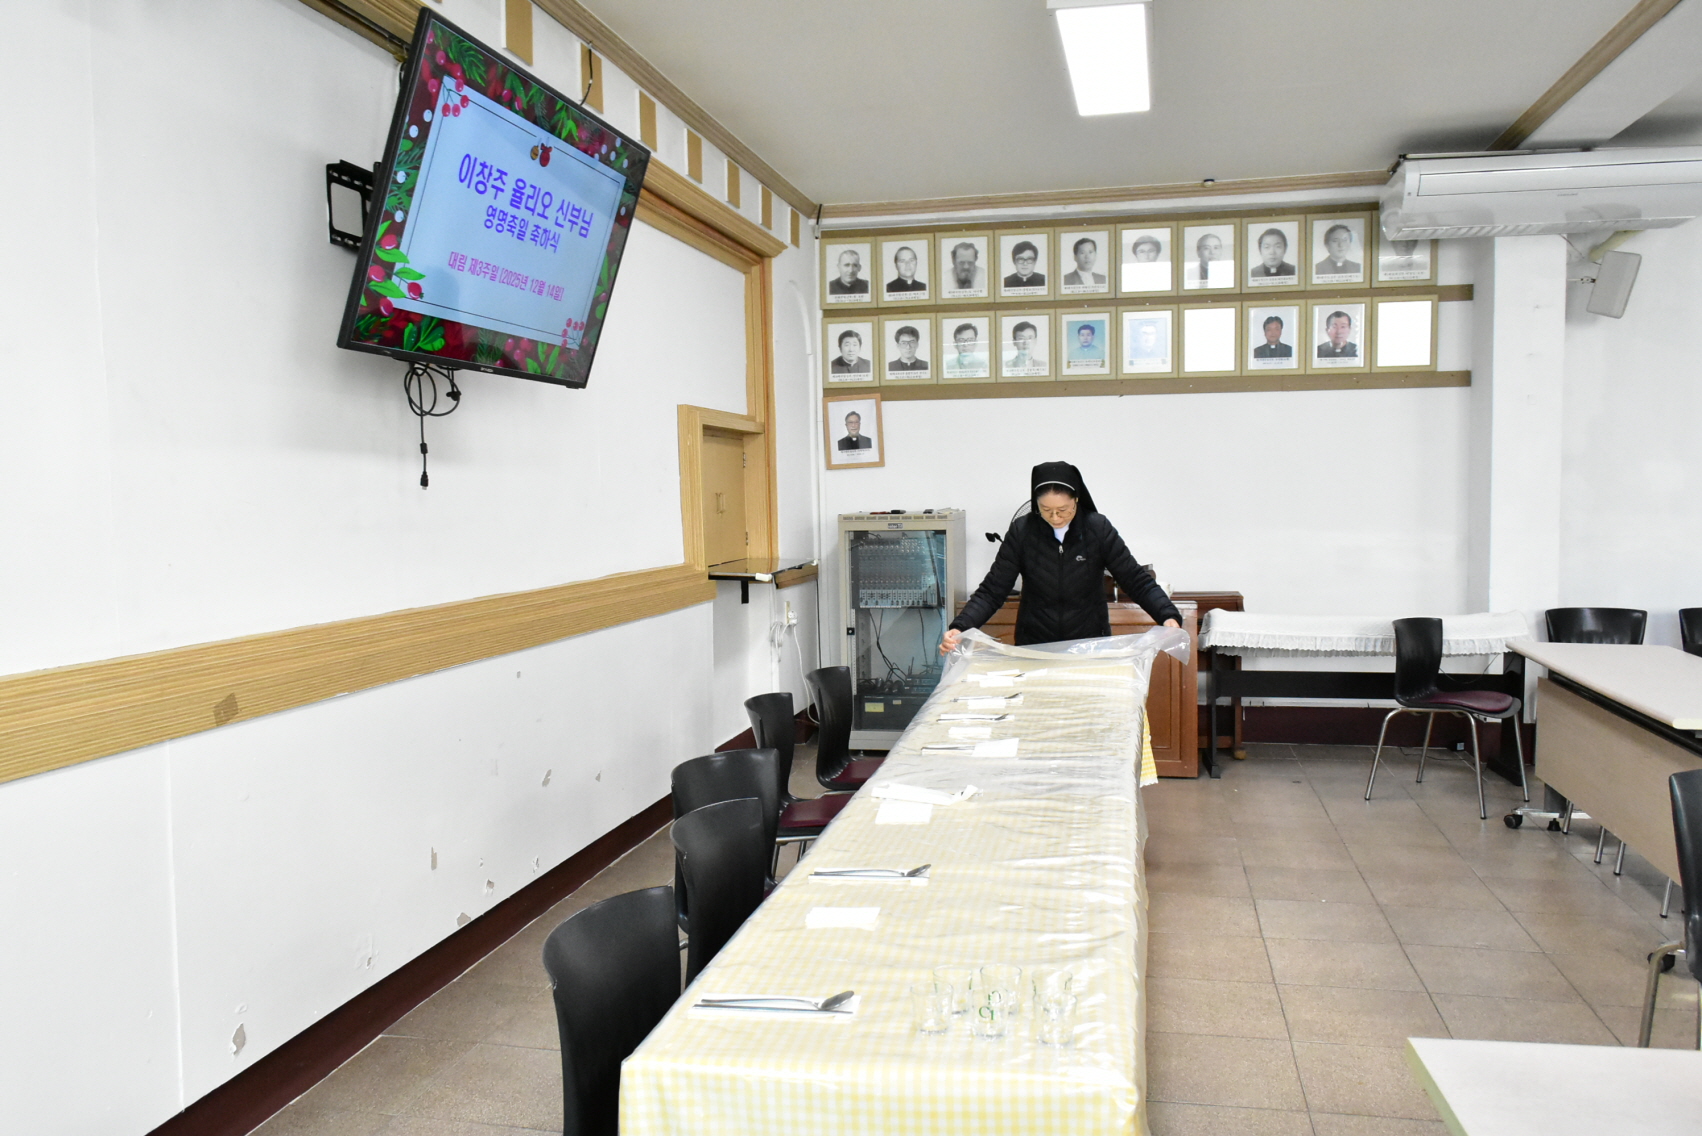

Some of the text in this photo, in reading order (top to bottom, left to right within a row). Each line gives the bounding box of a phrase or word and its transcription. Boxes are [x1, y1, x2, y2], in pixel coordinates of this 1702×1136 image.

[458, 153, 594, 239] 이창주 율리오 신부님
[484, 205, 561, 253] 영명축일 축하식
[448, 251, 468, 272] 대림
[468, 257, 500, 282] 제3주일
[529, 278, 547, 296] 12월
